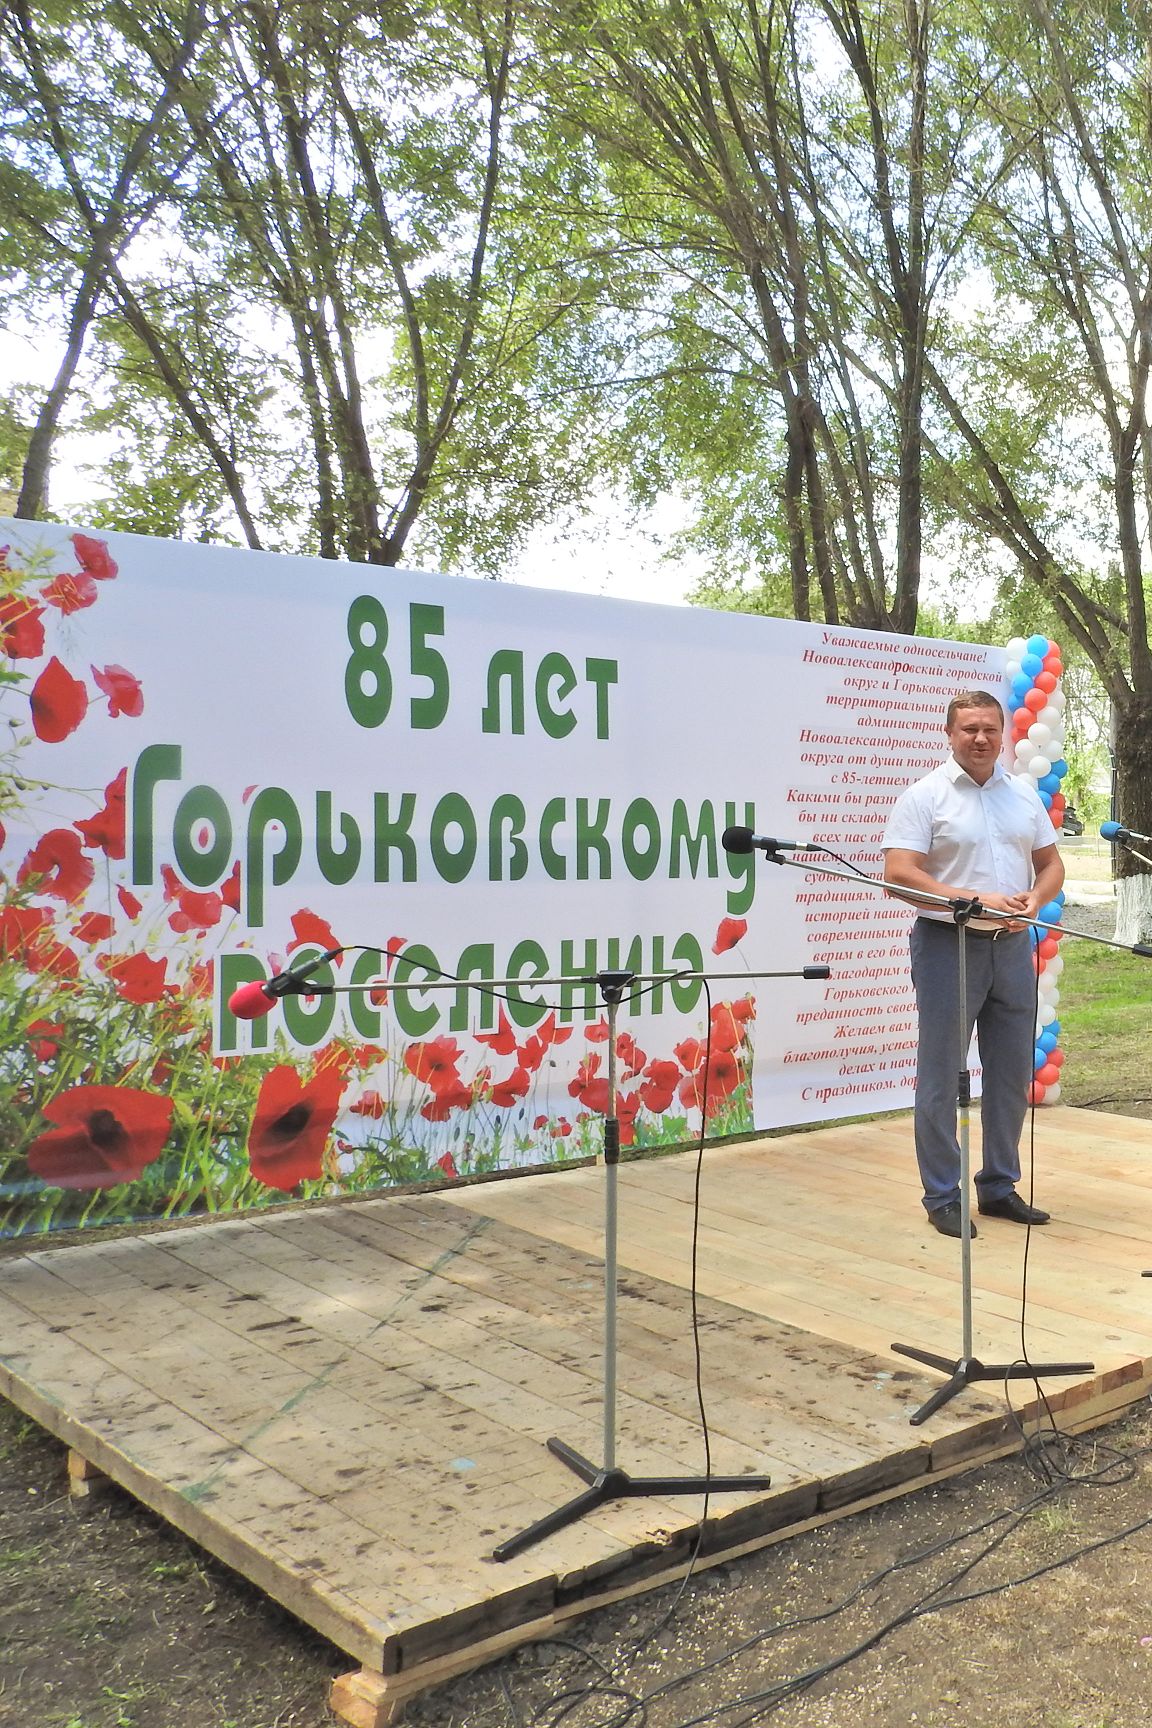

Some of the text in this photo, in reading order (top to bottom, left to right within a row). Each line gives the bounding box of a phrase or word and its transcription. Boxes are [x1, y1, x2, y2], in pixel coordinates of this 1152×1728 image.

[822, 632, 987, 663] Уважаемые односельчане!
[344, 594, 618, 740] 85 лет
[802, 649, 1002, 682] Новоалександровский городской
[843, 677, 879, 691] округ
[882, 680, 889, 690] и
[826, 695, 945, 713] территориальный
[857, 714, 946, 733] администрац
[799, 729, 943, 750] Новоалександровского
[800, 752, 844, 766] округа
[847, 755, 866, 765] от
[870, 754, 903, 768] души
[831, 774, 838, 783] с
[841, 771, 909, 786] 85-летием
[787, 789, 841, 803] Какими
[844, 791, 861, 803] бы
[799, 810, 889, 823] бы ни склады
[132, 744, 755, 927] Горьковскому
[813, 833, 841, 842] всех
[844, 834, 867, 842] нас
[792, 852, 846, 865] нашему
[795, 890, 876, 905] традициям.
[805, 908, 870, 924] историей
[807, 929, 903, 944] современными
[813, 952, 852, 964] верим
[857, 951, 864, 959] в
[867, 949, 885, 959] его
[220, 932, 703, 1051] поселению
[824, 985, 908, 1002] Горьковского
[796, 1006, 883, 1025] преданность
[833, 1024, 885, 1038] Желаем
[889, 1022, 911, 1032] вам
[783, 1045, 877, 1063] благополучия,
[838, 1063, 876, 1076] делах
[879, 1061, 886, 1070] и
[801, 1087, 812, 1101] С
